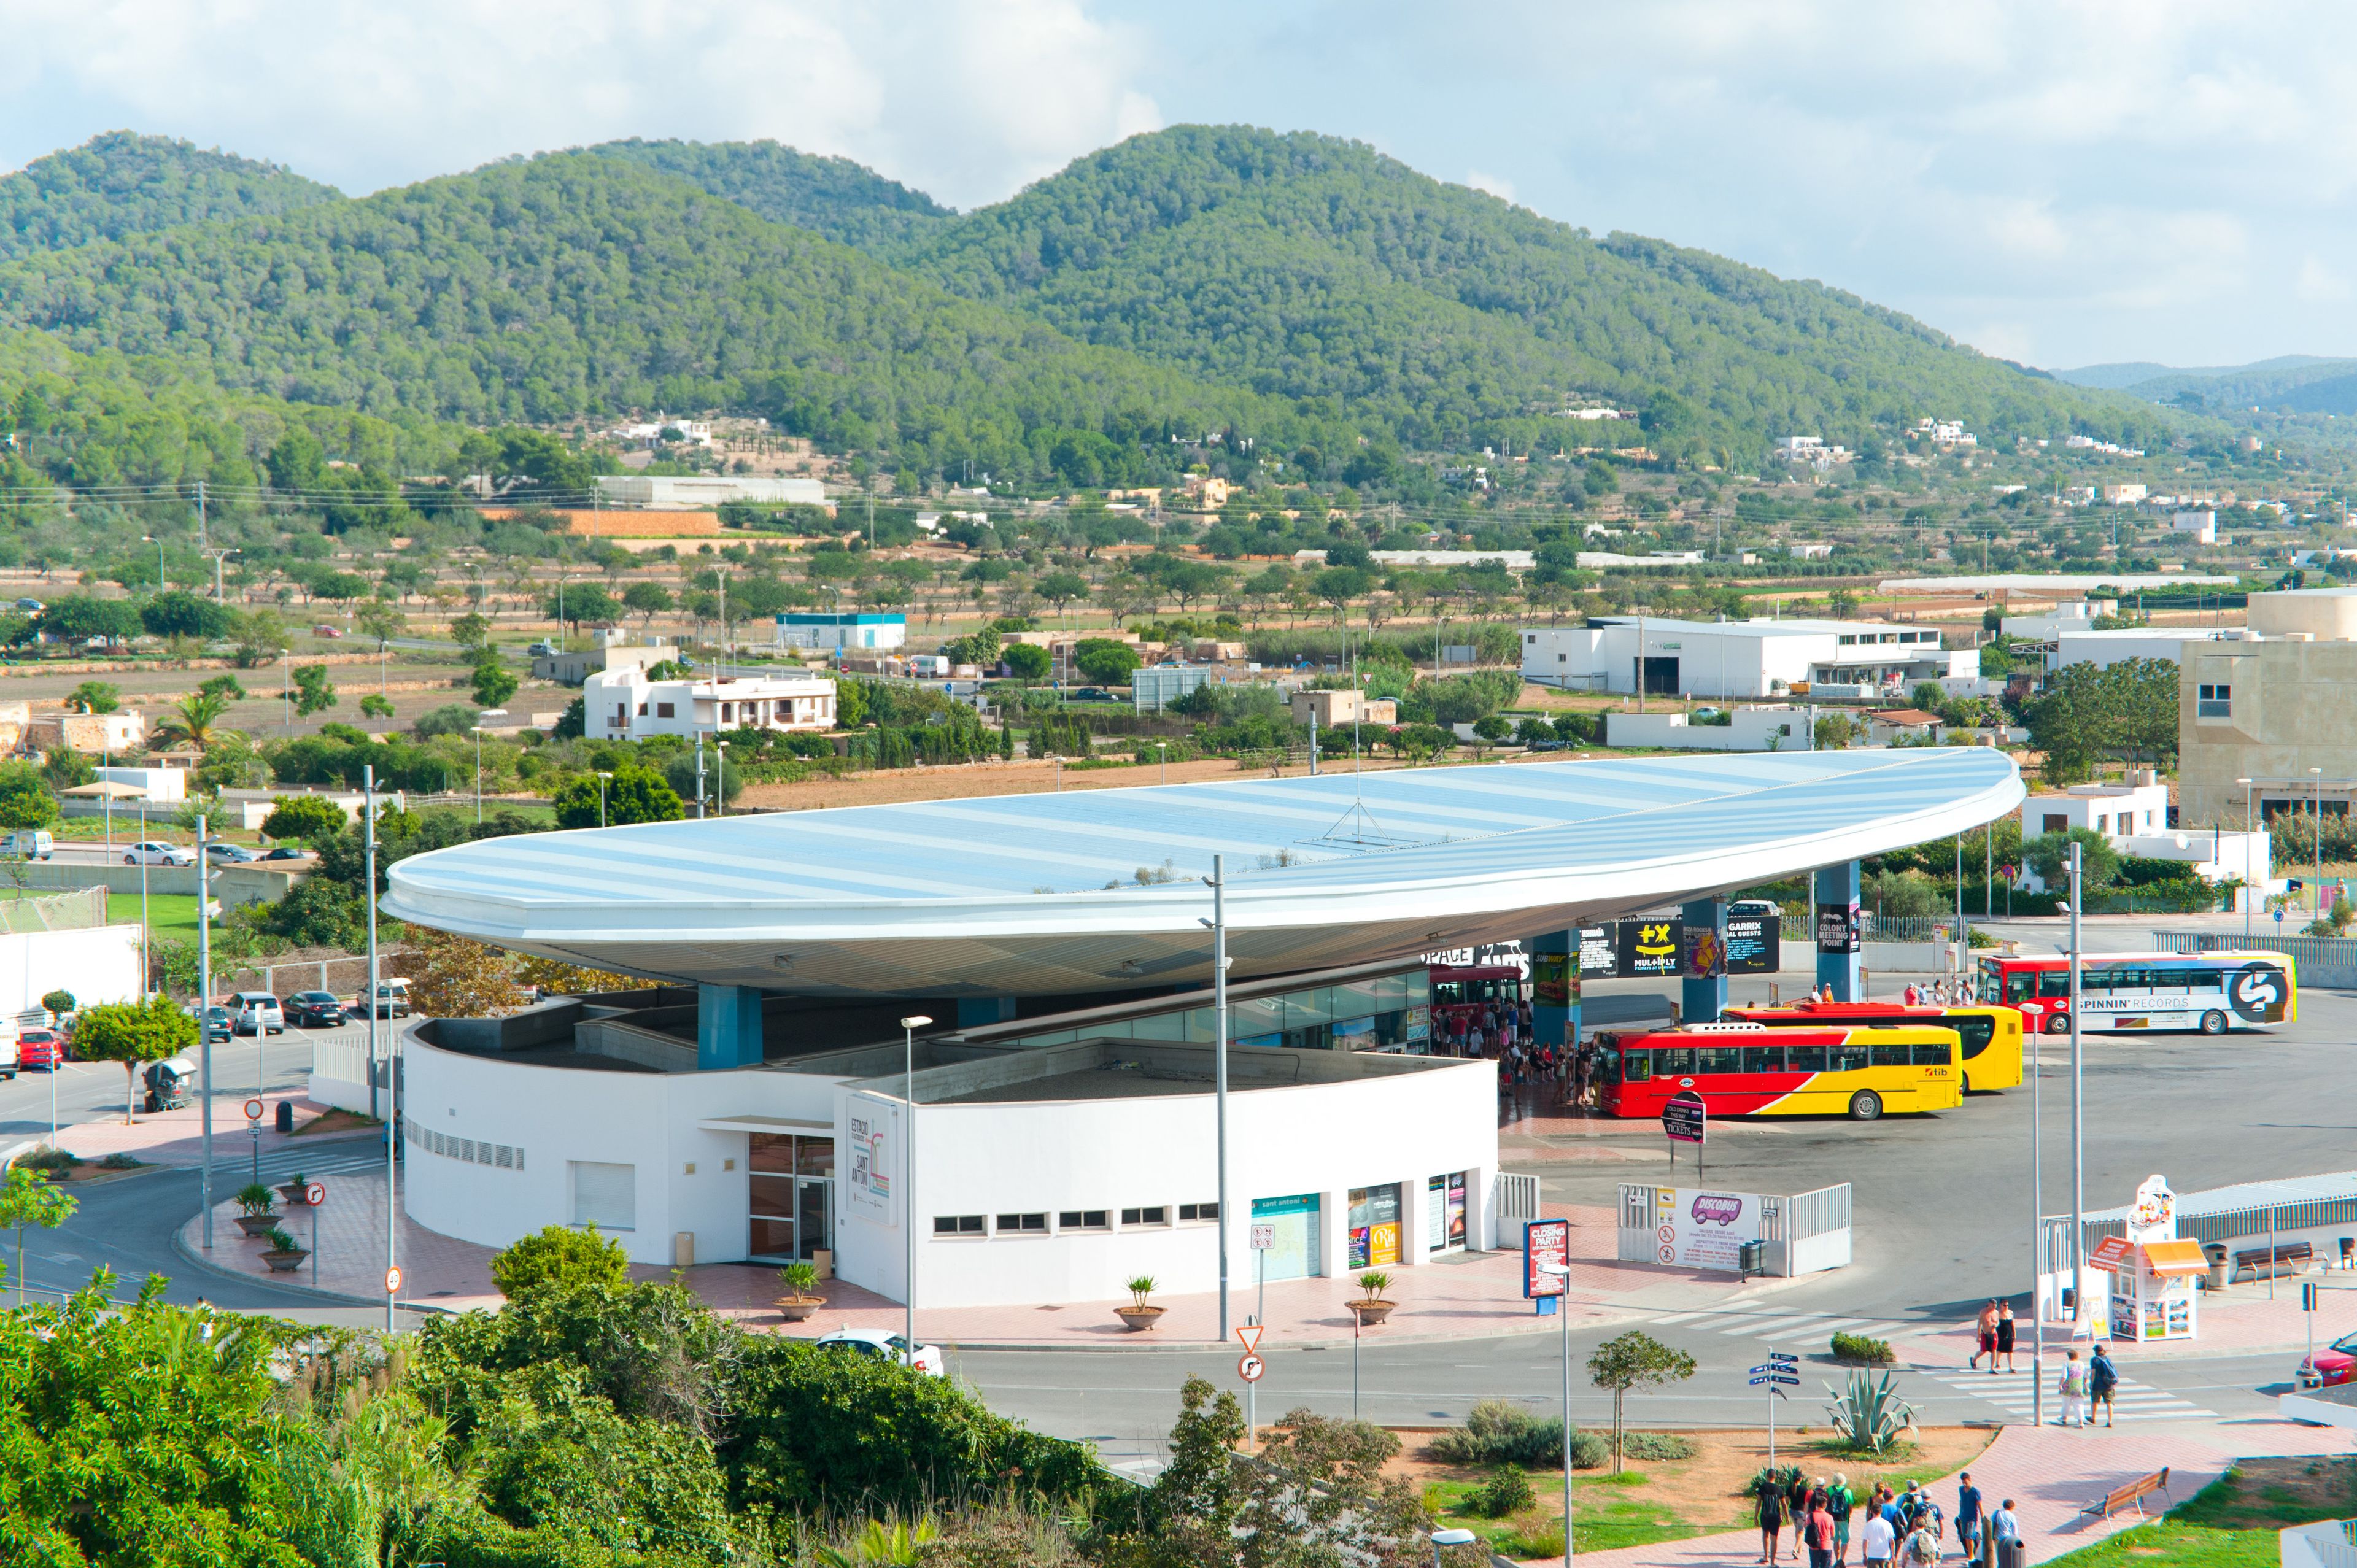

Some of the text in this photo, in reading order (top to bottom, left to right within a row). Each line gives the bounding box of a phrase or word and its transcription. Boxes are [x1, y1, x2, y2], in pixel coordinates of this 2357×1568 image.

[1728, 922, 1762, 931] GARRIX
[1819, 931, 1848, 940] MEETING
[1535, 954, 1566, 963] SUBWAY
[2133, 998, 2189, 1008] RECORDS
[851, 1118, 868, 1135] ESTACIÓ
[1667, 1124, 1690, 1135] TICKETS
[857, 1154, 868, 1169] SANT
[852, 1168, 868, 1187] ANTONI
[1279, 1197, 1300, 1206] antoni
[1698, 1198, 1738, 1211] DISCOBUS
[1531, 1227, 1565, 1238] CLOSING
[1536, 1236, 1561, 1246] PARTY
